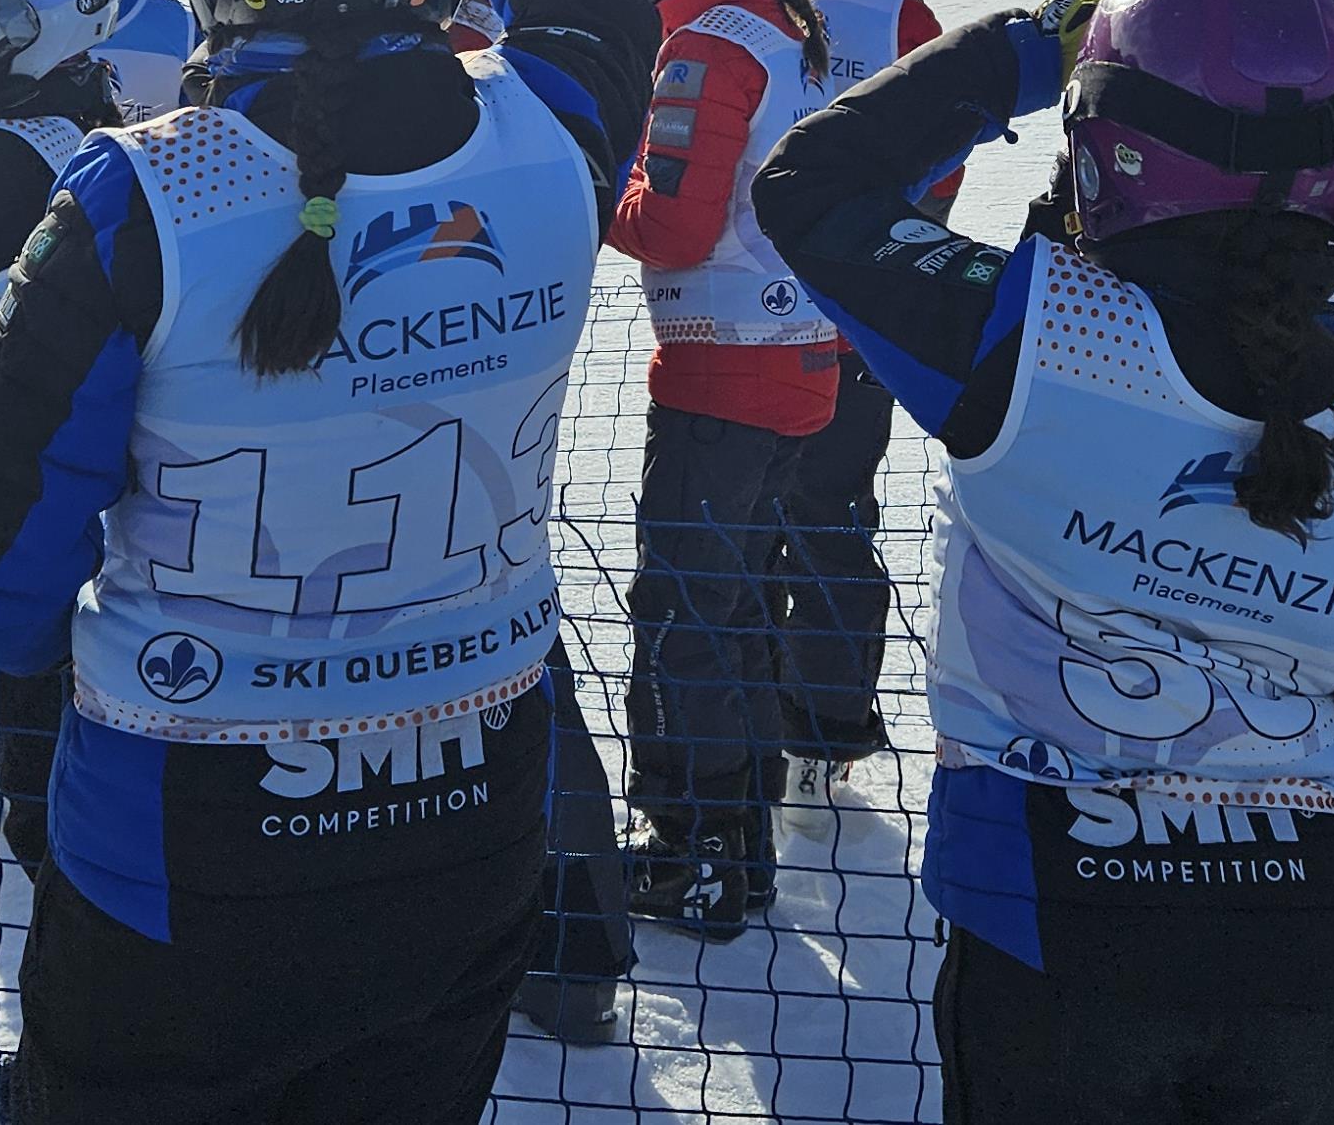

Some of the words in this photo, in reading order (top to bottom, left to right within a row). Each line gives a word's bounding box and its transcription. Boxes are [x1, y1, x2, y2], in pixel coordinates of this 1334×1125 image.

[313, 281, 566, 369] ACKENZIE
[351, 349, 509, 398] Placements
[1133, 573, 1275, 625] Placements
[251, 659, 329, 690] SKI
[346, 629, 501, 684] QUÉBEC
[261, 781, 489, 836] COMPETITION
[1076, 856, 1306, 883] COMPETITION
